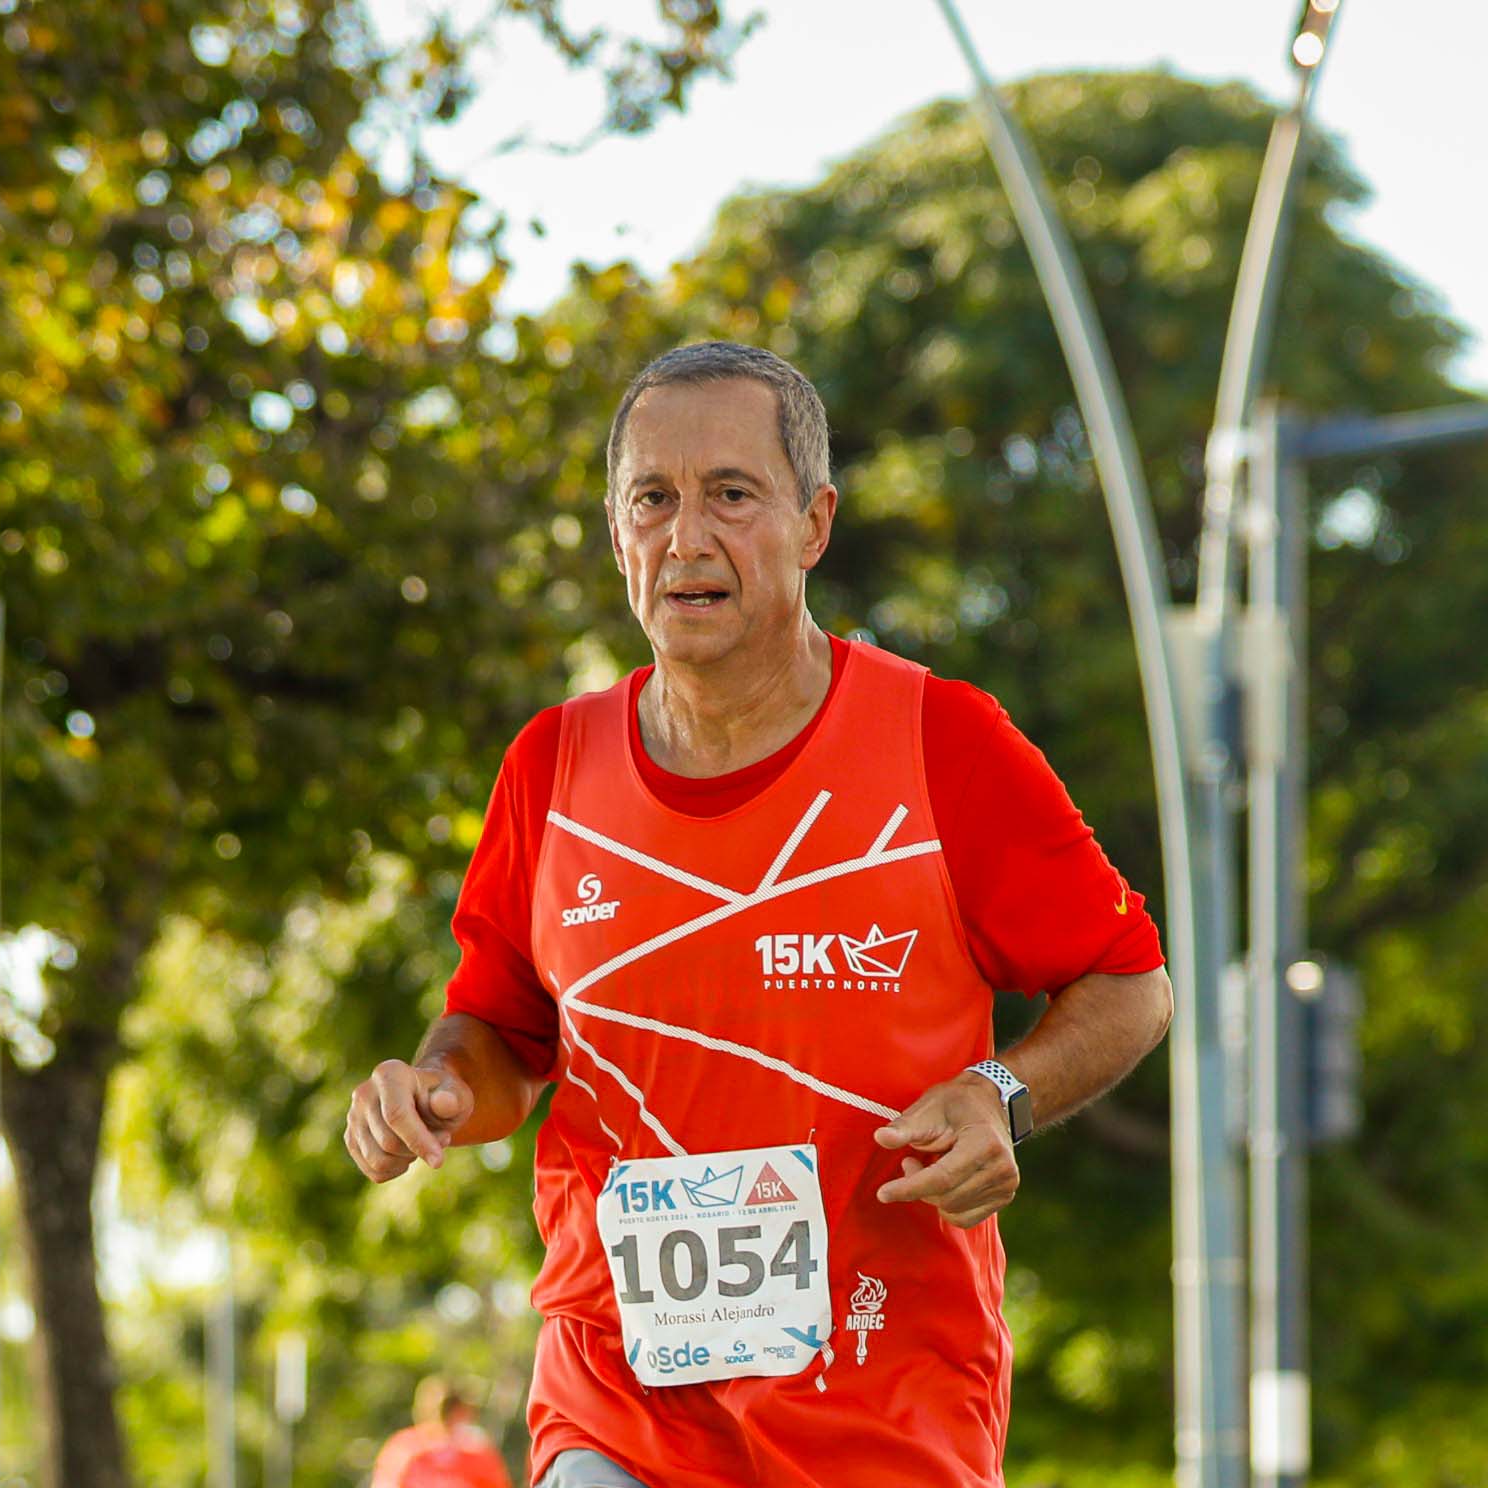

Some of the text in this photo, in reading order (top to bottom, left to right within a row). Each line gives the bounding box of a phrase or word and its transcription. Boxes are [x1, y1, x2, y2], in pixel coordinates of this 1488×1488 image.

[755, 934, 837, 976] 15K
[764, 979, 901, 993] PUERTO NORTE
[615, 1179, 677, 1214] 15K
[754, 1180, 785, 1200] 15K
[611, 1220, 818, 1304] 1054
[654, 1304, 775, 1327] Morassi Alejandro
[846, 1314, 885, 1330] ARDEC
